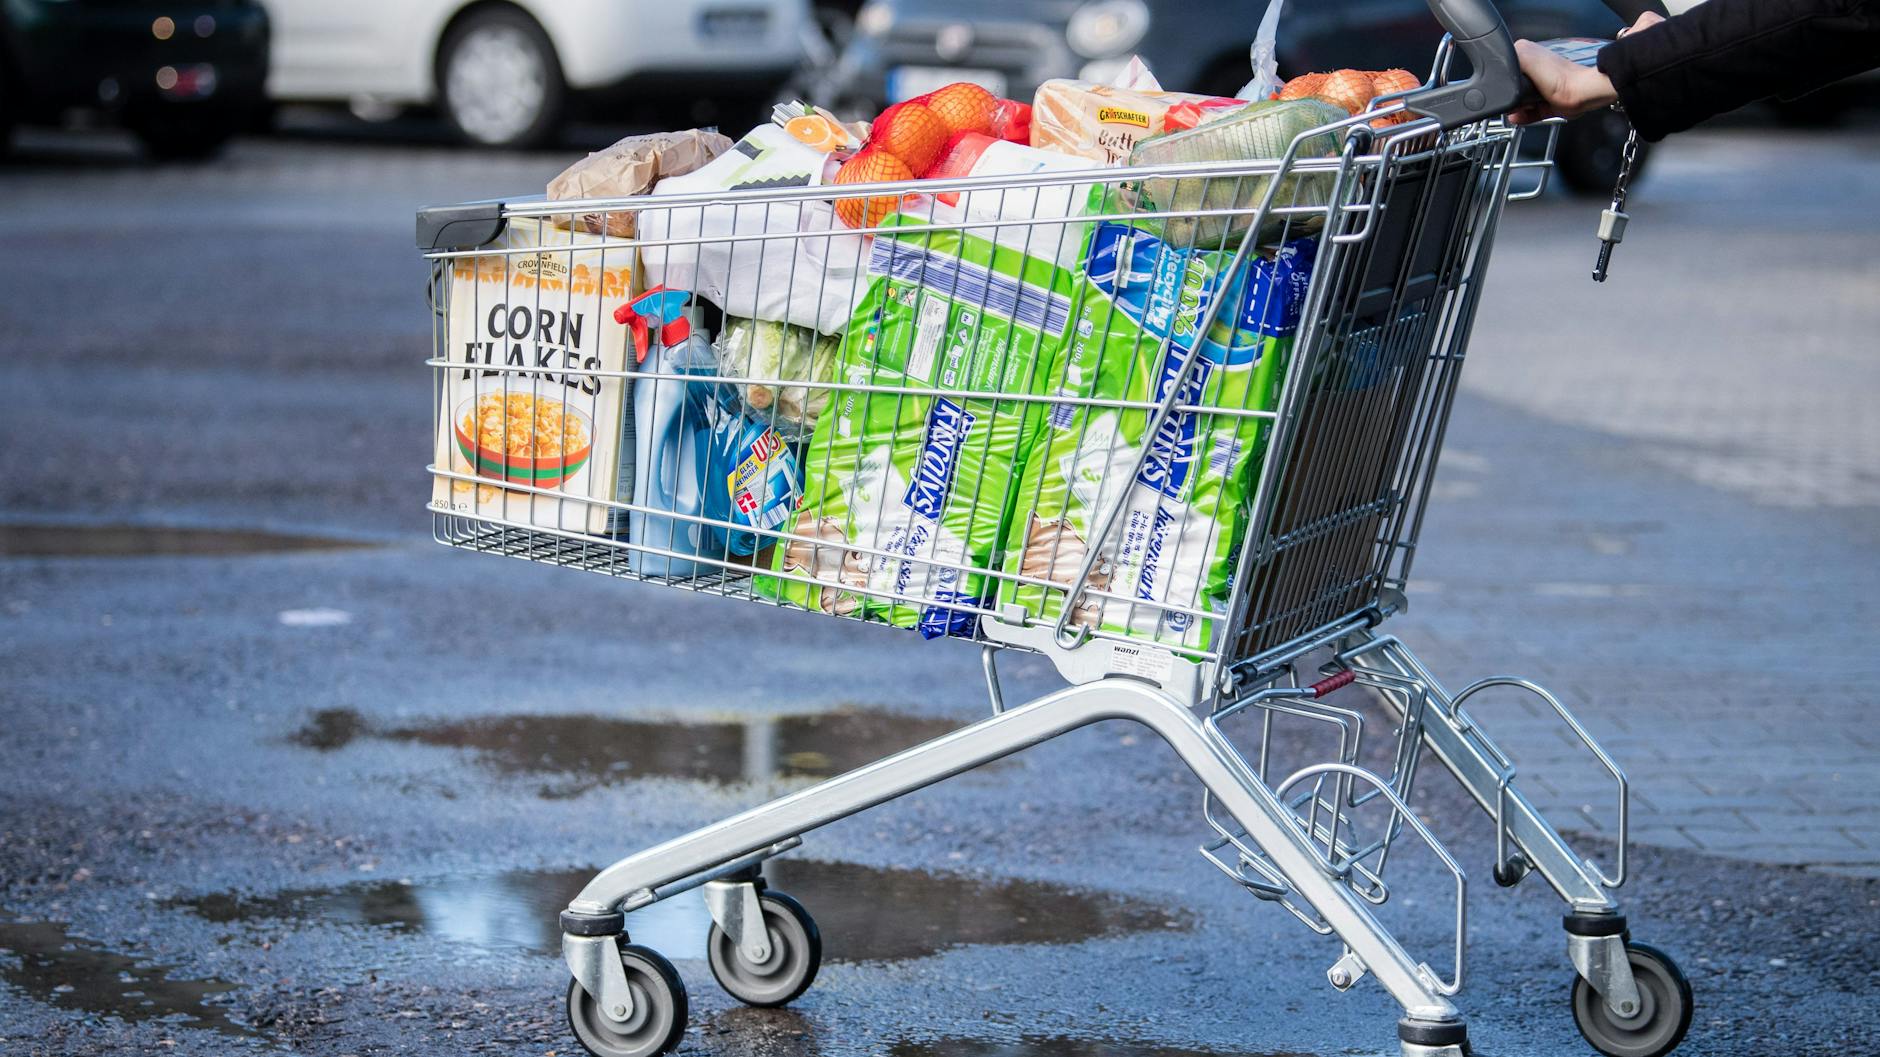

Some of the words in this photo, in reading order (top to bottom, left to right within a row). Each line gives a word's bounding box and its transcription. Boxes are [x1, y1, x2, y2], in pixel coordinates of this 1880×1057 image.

[488, 303, 584, 349] CORN
[1156, 248, 1182, 331] Recycling
[1173, 255, 1206, 337] 100%
[463, 342, 602, 397] FLAKES
[910, 402, 961, 515] Floralys
[1143, 349, 1205, 488] Floalys
[1114, 645, 1140, 656] wanzl
